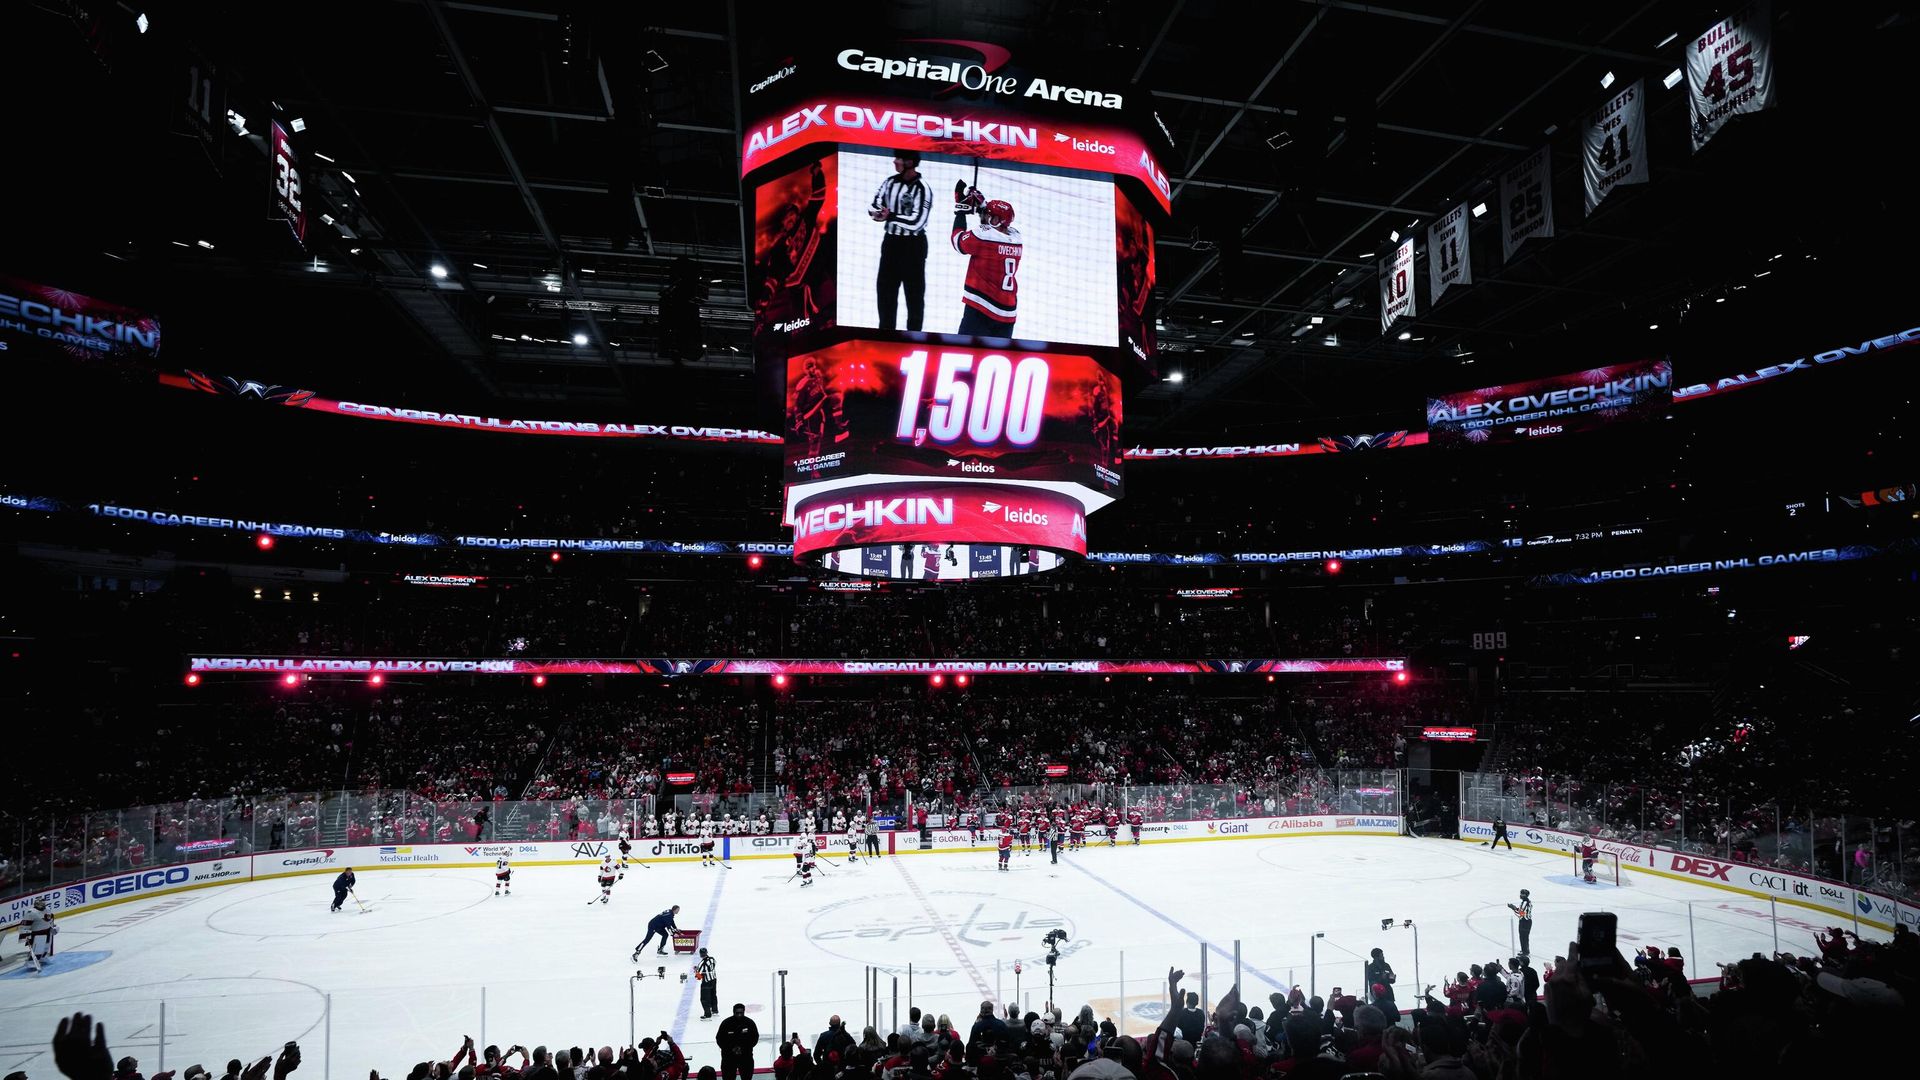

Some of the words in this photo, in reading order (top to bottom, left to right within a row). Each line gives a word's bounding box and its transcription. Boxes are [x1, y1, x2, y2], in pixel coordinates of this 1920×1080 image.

[1714, 34, 1741, 59] PHIL
[1703, 41, 1753, 104] 45
[1023, 78, 1123, 110] Arena
[746, 104, 830, 160] ALEX
[834, 103, 1038, 149] OVECHKIN
[1603, 115, 1621, 133] WES
[1072, 137, 1116, 156] leidos
[1599, 125, 1631, 171] 41
[276, 153, 302, 213] 32
[1511, 182, 1542, 229] 25
[1434, 206, 1463, 234] BULLETS
[1441, 237, 1458, 272] 11
[1002, 258, 1016, 292] 8
[1387, 270, 1407, 304] 10
[784, 317, 811, 333] leidos
[37, 327, 111, 351] GAMES
[1715, 358, 1812, 390] ALEX
[896, 350, 1051, 448] 1,500
[1431, 400, 1504, 425] ALEX
[1508, 372, 1671, 414] OVECHKIN
[1495, 411, 1548, 424] CAREER
[1550, 407, 1578, 420] NHL
[1580, 396, 1633, 412] GAMES
[338, 402, 600, 434] CONGRATULATIONS
[603, 422, 671, 436] ALEX
[1528, 424, 1563, 437] leidos
[815, 452, 846, 463] CAREER
[1124, 445, 1184, 457] ALEX
[1185, 443, 1299, 456] OVECHKIN
[797, 463, 813, 473] NHL
[813, 460, 841, 471] GAMES
[961, 460, 998, 475] leidos
[1785, 502, 1806, 510] SHOTS
[1790, 508, 1796, 517] 2
[1004, 505, 1049, 527] leidos
[152, 511, 234, 529] CAREER
[237, 519, 276, 533] NHL
[278, 524, 345, 538] GAMES
[390, 533, 417, 543] leidos
[499, 537, 558, 548] CAREER
[560, 539, 590, 549] NHL
[593, 540, 644, 550] GAMES
[1575, 533, 1590, 541] 7:32
[682, 542, 705, 552] leidos
[1269, 551, 1321, 562] CAREER
[1322, 551, 1350, 560] NHL
[1352, 547, 1402, 559] GAMES
[1441, 543, 1466, 553] leidos
[1109, 552, 1151, 561] GAMES
[1183, 555, 1204, 563] leidos
[1639, 562, 1712, 577] CAREER
[1715, 558, 1755, 570] NHL
[1759, 548, 1839, 567] GAMES
[429, 576, 477, 584] OVECHKIN
[870, 568, 889, 576] CAESARS
[375, 659, 423, 672] ALEX
[425, 660, 514, 673] OVECHKIN
[843, 661, 985, 673] CONGRATULATIONS
[988, 661, 1027, 671] ALEX
[1028, 661, 1100, 672] OVECHKIN
[1219, 822, 1249, 834] Giant
[1281, 818, 1323, 830] Alibaba
[1356, 818, 1398, 829] AMAZING
[752, 837, 793, 847] GDIT
[938, 835, 968, 844] GLOBAL
[380, 854, 412, 862] MedStar
[413, 853, 439, 862] Health
[575, 842, 604, 858] AV
[1671, 855, 1733, 882] DEX
[92, 867, 189, 899] GEICO
[1750, 872, 1786, 891] CACI
[1820, 886, 1845, 899] DELL
